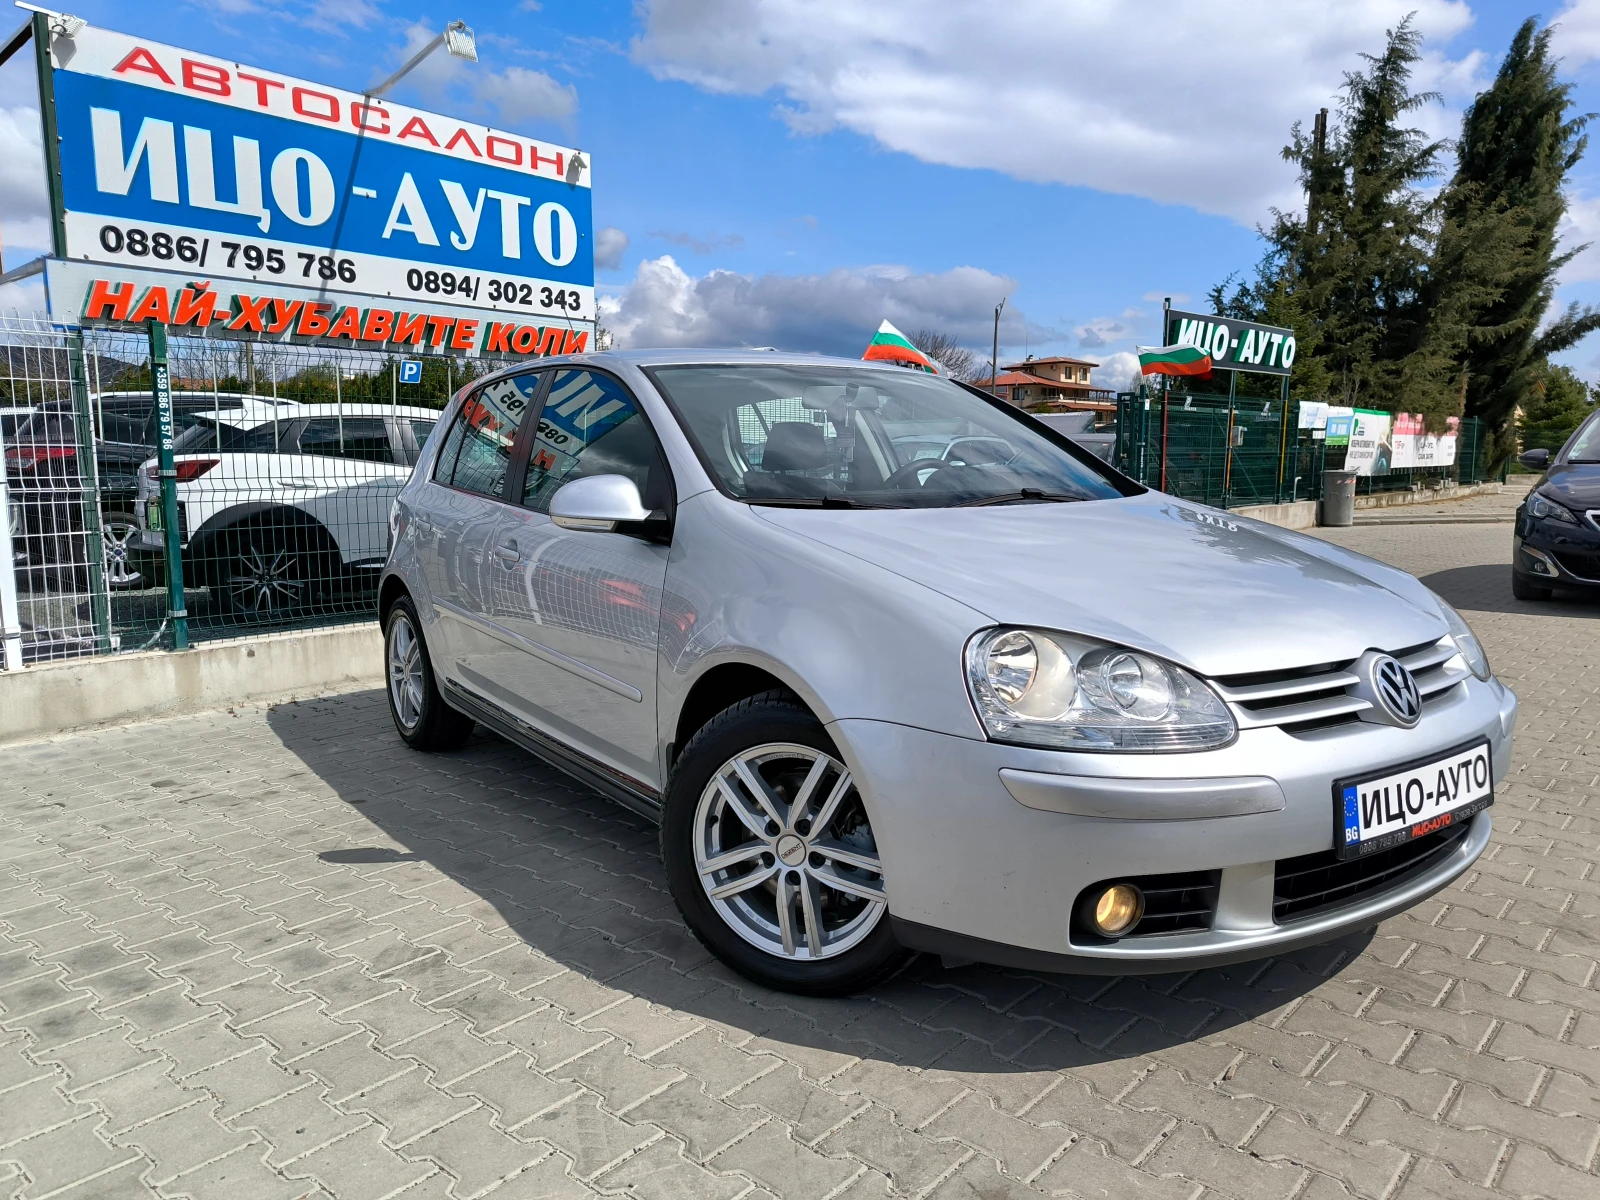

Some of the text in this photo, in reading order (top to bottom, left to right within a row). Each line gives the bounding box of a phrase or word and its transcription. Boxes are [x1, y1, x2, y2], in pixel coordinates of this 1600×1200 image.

[112, 46, 565, 176] АВТОСАЛОН
[99, 225, 581, 311] 0886/ 795 786 0894/ 302 343
[83, 279, 589, 356] НАЙ-ХУБАВИТЕ КОЛИ
[156, 366, 173, 450] +359 886 79 57 86
[404, 363, 417, 380] P
[1361, 754, 1488, 829] ИЦО-АУТО
[1411, 813, 1451, 838] ИЦО-АУТО
[1345, 826, 1359, 841] BG
